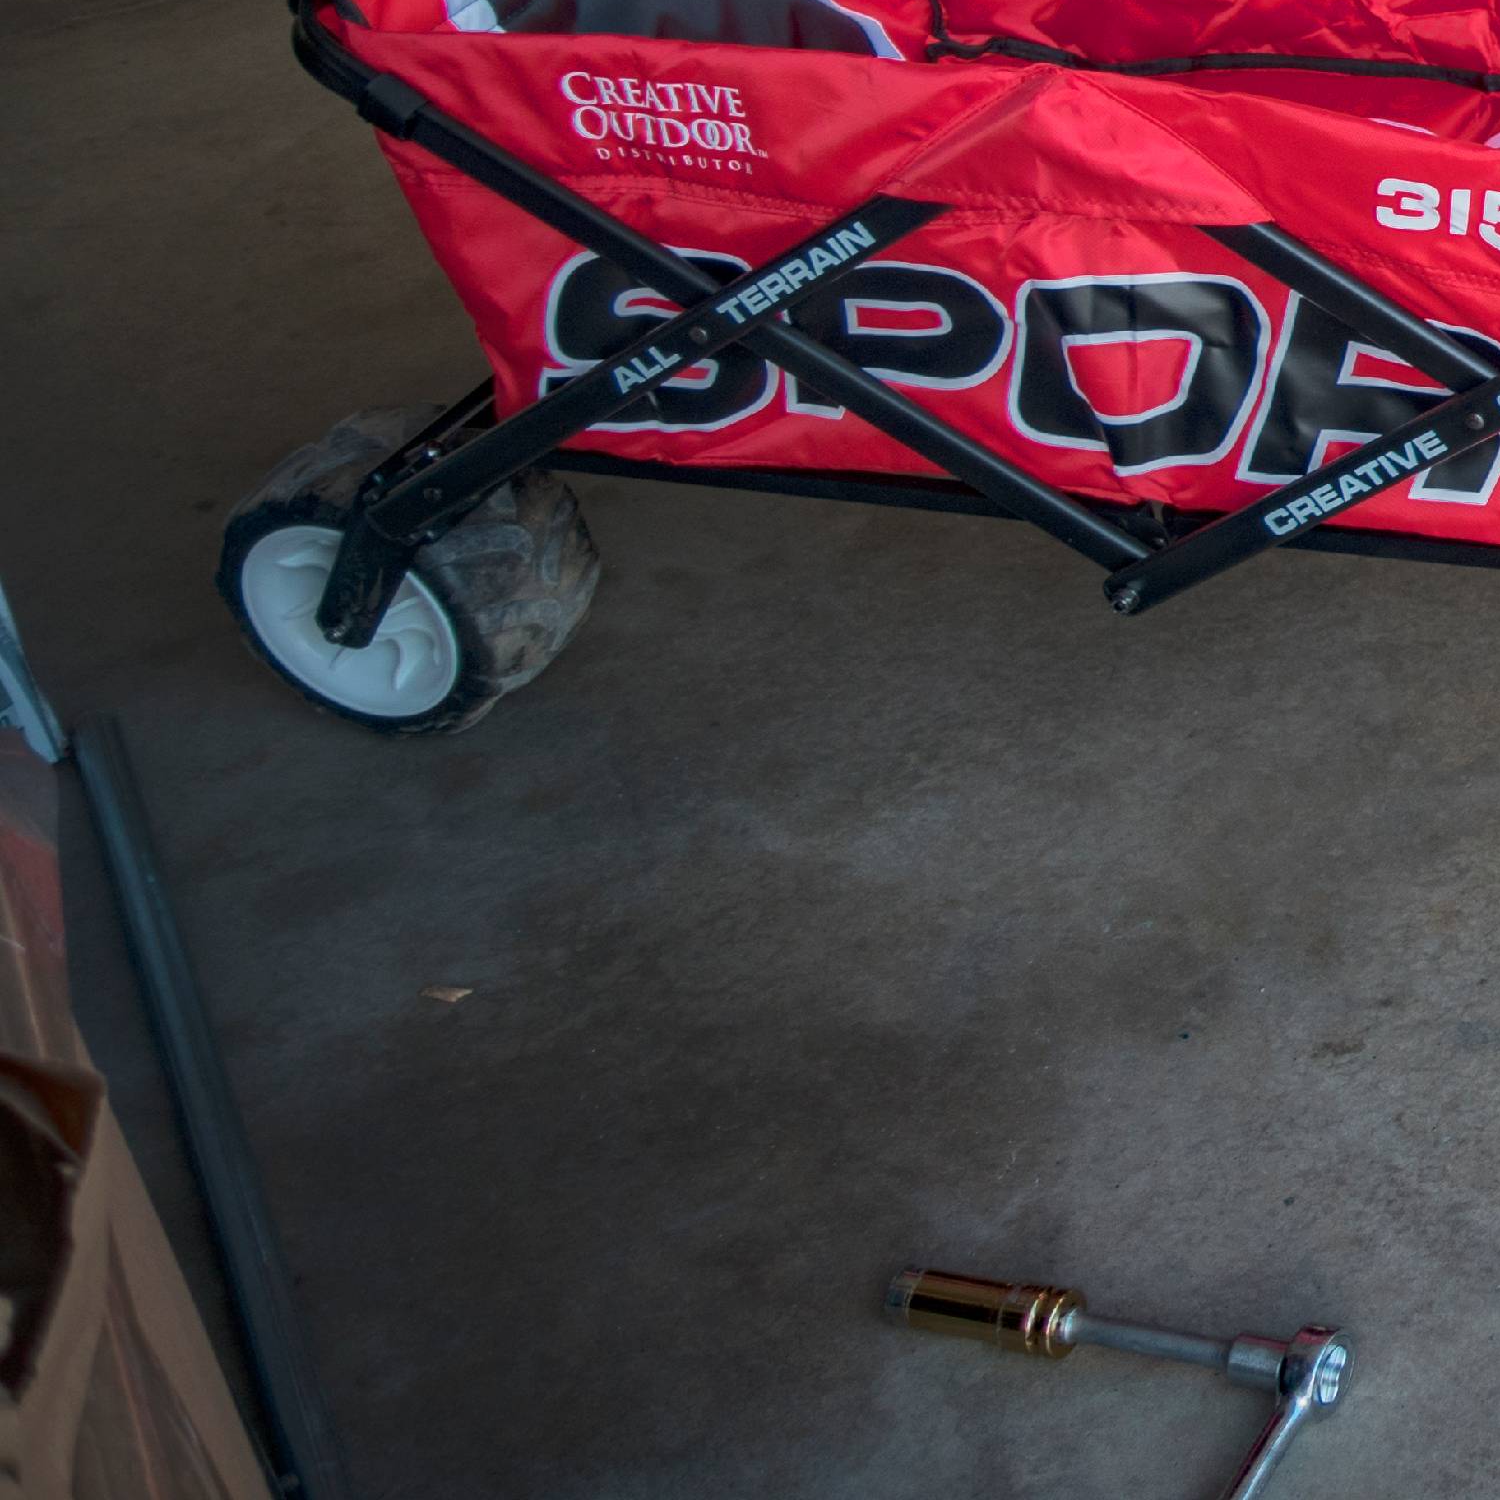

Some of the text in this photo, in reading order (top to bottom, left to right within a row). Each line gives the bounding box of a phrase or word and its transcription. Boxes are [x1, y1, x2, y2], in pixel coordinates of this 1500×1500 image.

[560, 70, 747, 118] CREATIVE
[573, 106, 758, 156] OUTDOOR
[611, 219, 881, 396] ALL TERRAIN
[1263, 429, 1450, 538] CREATIVE
